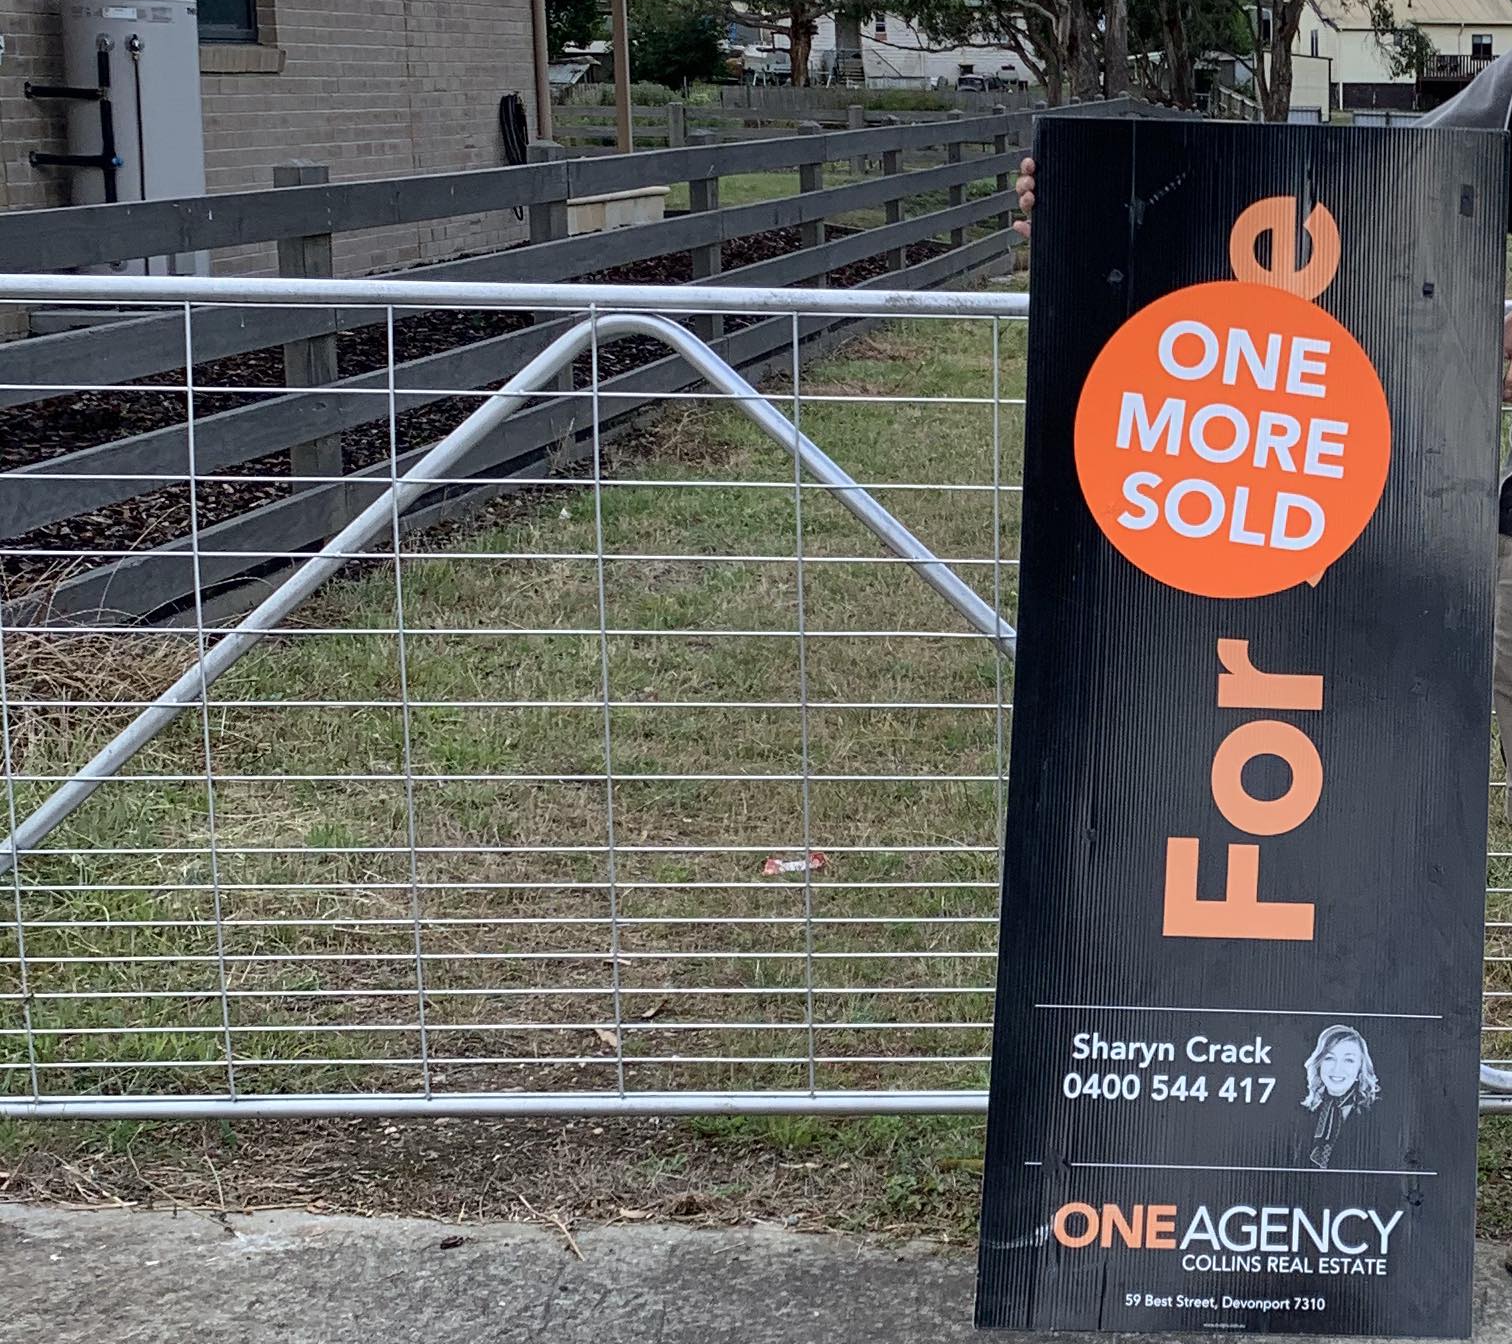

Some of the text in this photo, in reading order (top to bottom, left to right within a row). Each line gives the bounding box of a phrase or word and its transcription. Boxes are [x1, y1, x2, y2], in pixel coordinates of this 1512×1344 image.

[1158, 320, 1331, 398] ONE
[1115, 391, 1349, 479] MORE
[1117, 471, 1326, 551] SOLD
[1163, 638, 1323, 940] For
[1071, 1031, 1273, 1069] Sharyn Crack
[1062, 1071, 1277, 1104] 0400 544 417
[1181, 1253, 1387, 1276] COLLINS REAL ESTATE
[1124, 1292, 1326, 1313] 59 Best Street, Devonport 7310
